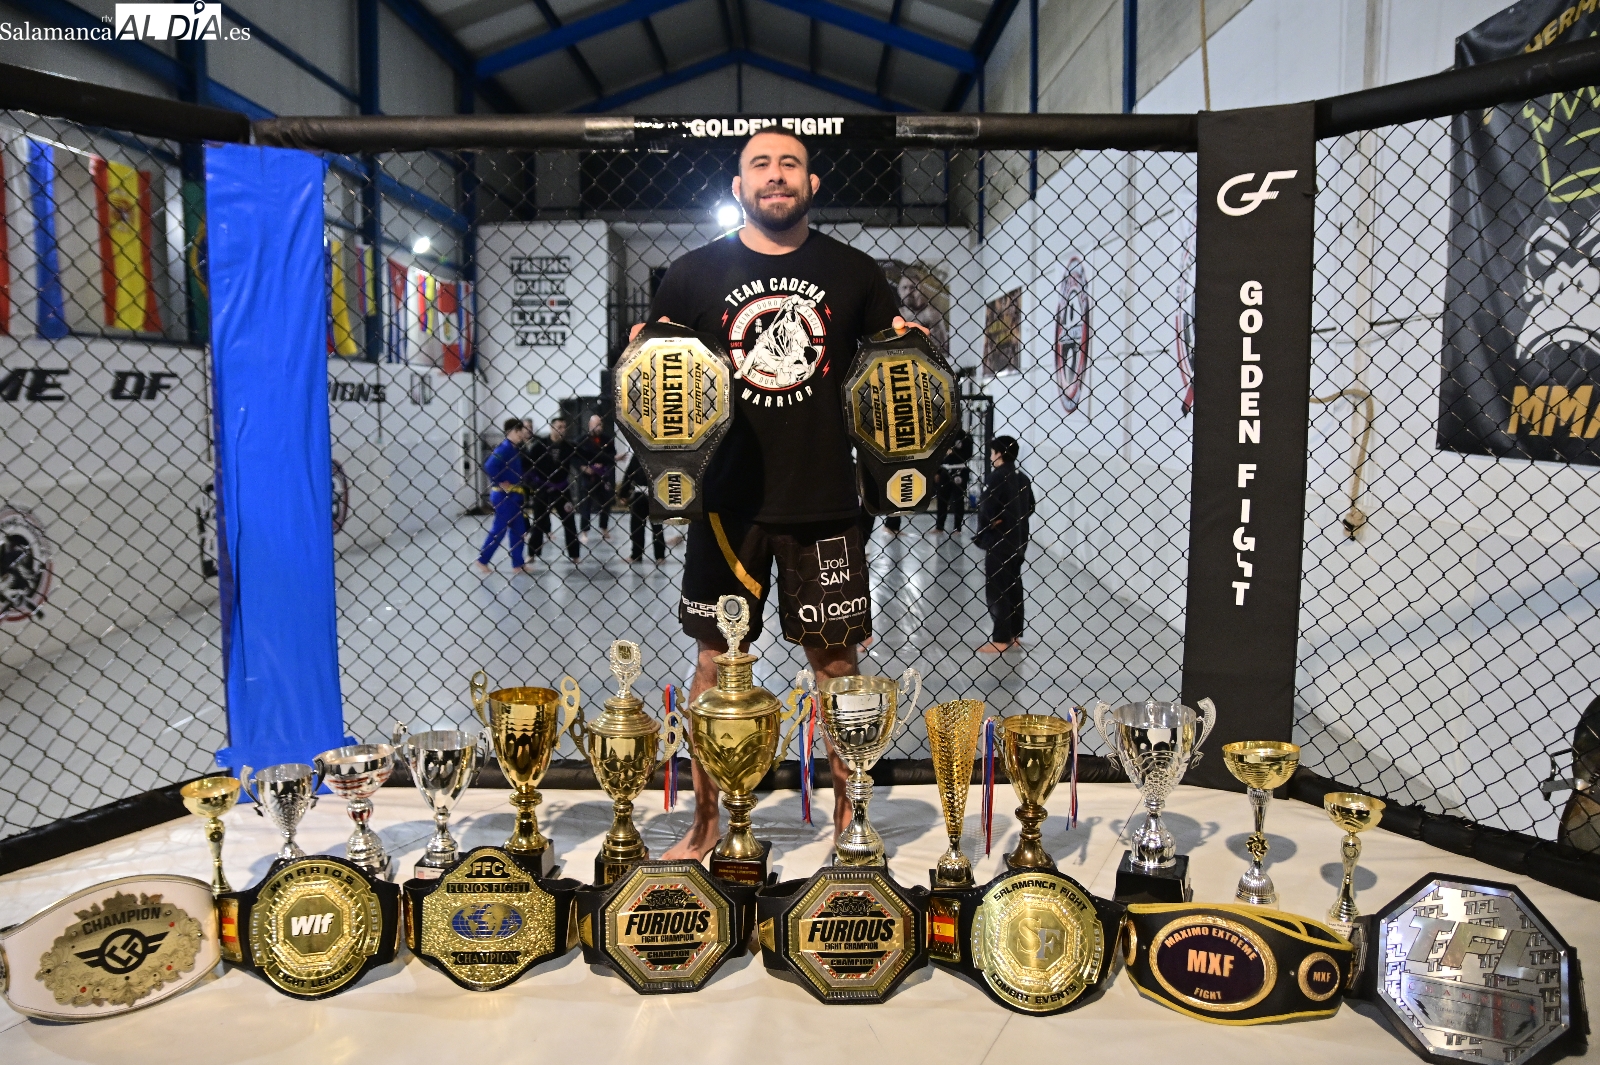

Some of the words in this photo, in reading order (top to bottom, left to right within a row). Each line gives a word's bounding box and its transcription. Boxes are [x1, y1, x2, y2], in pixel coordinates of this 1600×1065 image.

[725, 280, 765, 307] TEAM
[770, 277, 826, 303] CADENA
[1238, 280, 1264, 444] GOLDEN
[111, 371, 177, 400] OF
[327, 381, 386, 402] IONS
[663, 352, 683, 437] VENDETTA
[741, 385, 813, 408] WARRIOR
[872, 385, 883, 431] WORLD
[889, 362, 916, 449] VENDETTA
[921, 372, 933, 435] CHAMPION
[668, 474, 681, 505] MMA
[901, 474, 913, 503] MMA
[823, 557, 845, 570] TOP
[821, 569, 850, 586] SAN
[687, 606, 717, 618] SPOR
[828, 597, 867, 616] acm
[271, 866, 354, 893] WARRIOS
[472, 861, 504, 876] FFC
[448, 883, 489, 893] FURIOS
[492, 883, 528, 893] FIGHT
[993, 879, 1057, 901] SALAMANCA
[1059, 886, 1088, 912] FIGHT
[1413, 904, 1449, 918] TFL
[1464, 899, 1499, 915] TFL
[82, 906, 162, 935] CHAMPION
[625, 910, 711, 936] FURIOUS
[808, 918, 896, 943] FURIOUS
[641, 935, 659, 944] FIGHT
[660, 934, 694, 943] CHAMPION
[824, 943, 842, 951] FIGHT
[844, 942, 879, 951] CHAMPION
[1016, 917, 1060, 960] SF
[1164, 926, 1208, 949] MAXIMO
[1212, 927, 1257, 962] EXTREME
[1406, 915, 1541, 982] TFL
[456, 952, 518, 965] CHAMPION
[647, 950, 690, 959] CHAMPION
[830, 958, 874, 966] CHAMPION
[1187, 949, 1235, 978] MXF
[276, 969, 306, 988] FIGHT
[311, 963, 354, 988] LEAGUE
[1313, 971, 1332, 983] MXF
[991, 973, 1031, 1004] COMBAT
[1035, 984, 1077, 1004] EVENTS
[1194, 987, 1222, 1000] FIGHT
